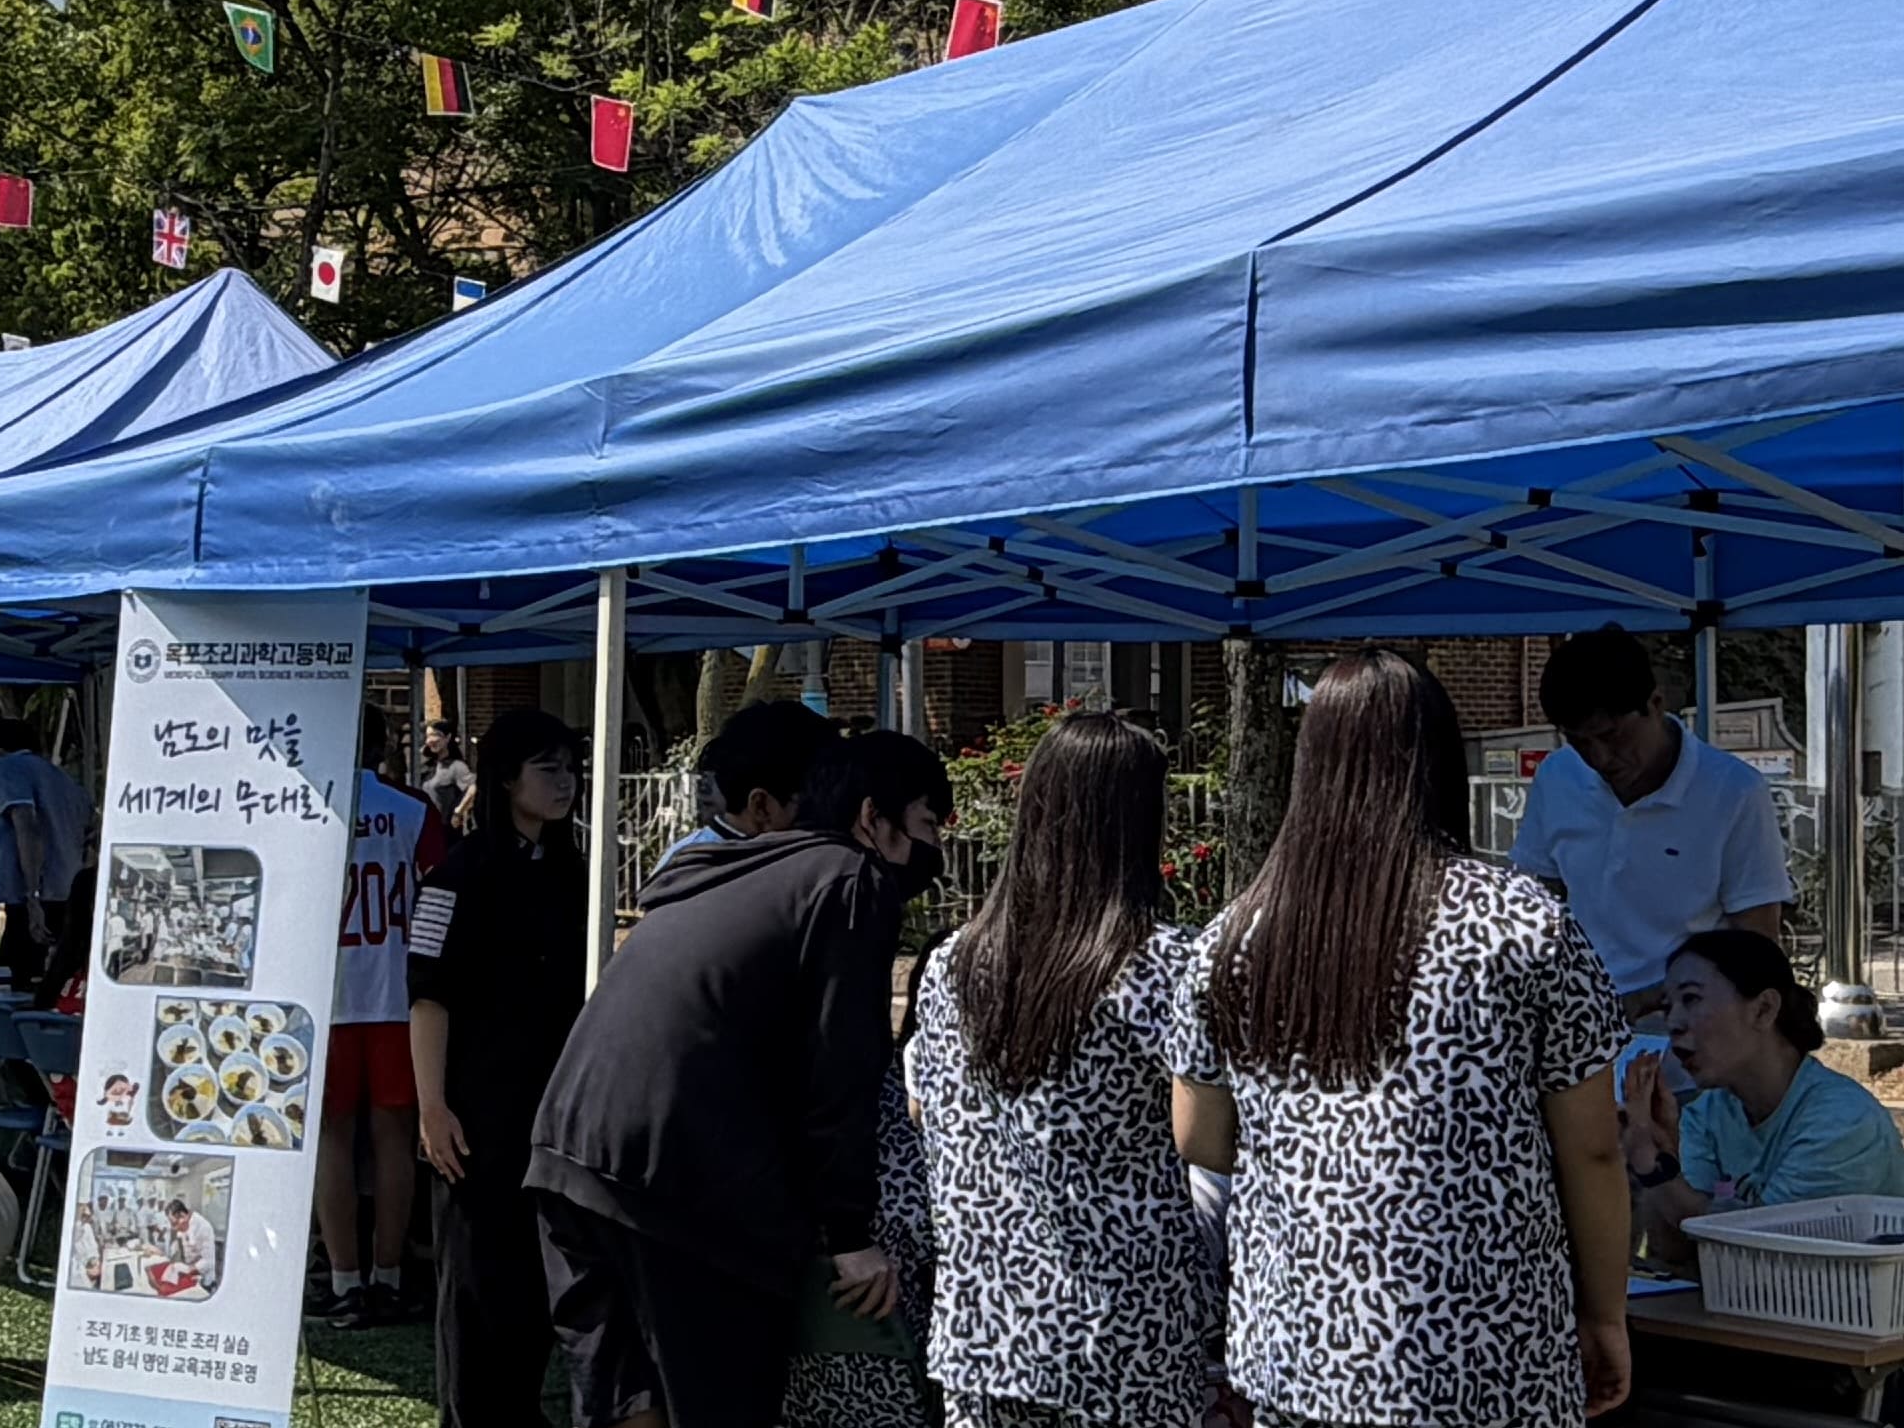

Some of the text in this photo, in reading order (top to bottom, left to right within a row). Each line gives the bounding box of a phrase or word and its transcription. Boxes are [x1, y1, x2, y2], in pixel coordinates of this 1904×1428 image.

[166, 642, 353, 666] 목포조리과학고등학교
[155, 713, 304, 768] 남도의 맛을
[119, 780, 334, 824] 세계의 무대로!
[83, 1346, 108, 1366] 남도
[86, 1320, 112, 1341] 조리
[115, 1323, 141, 1342] 기초
[191, 1332, 219, 1352] 조리
[223, 1335, 250, 1356] 실습
